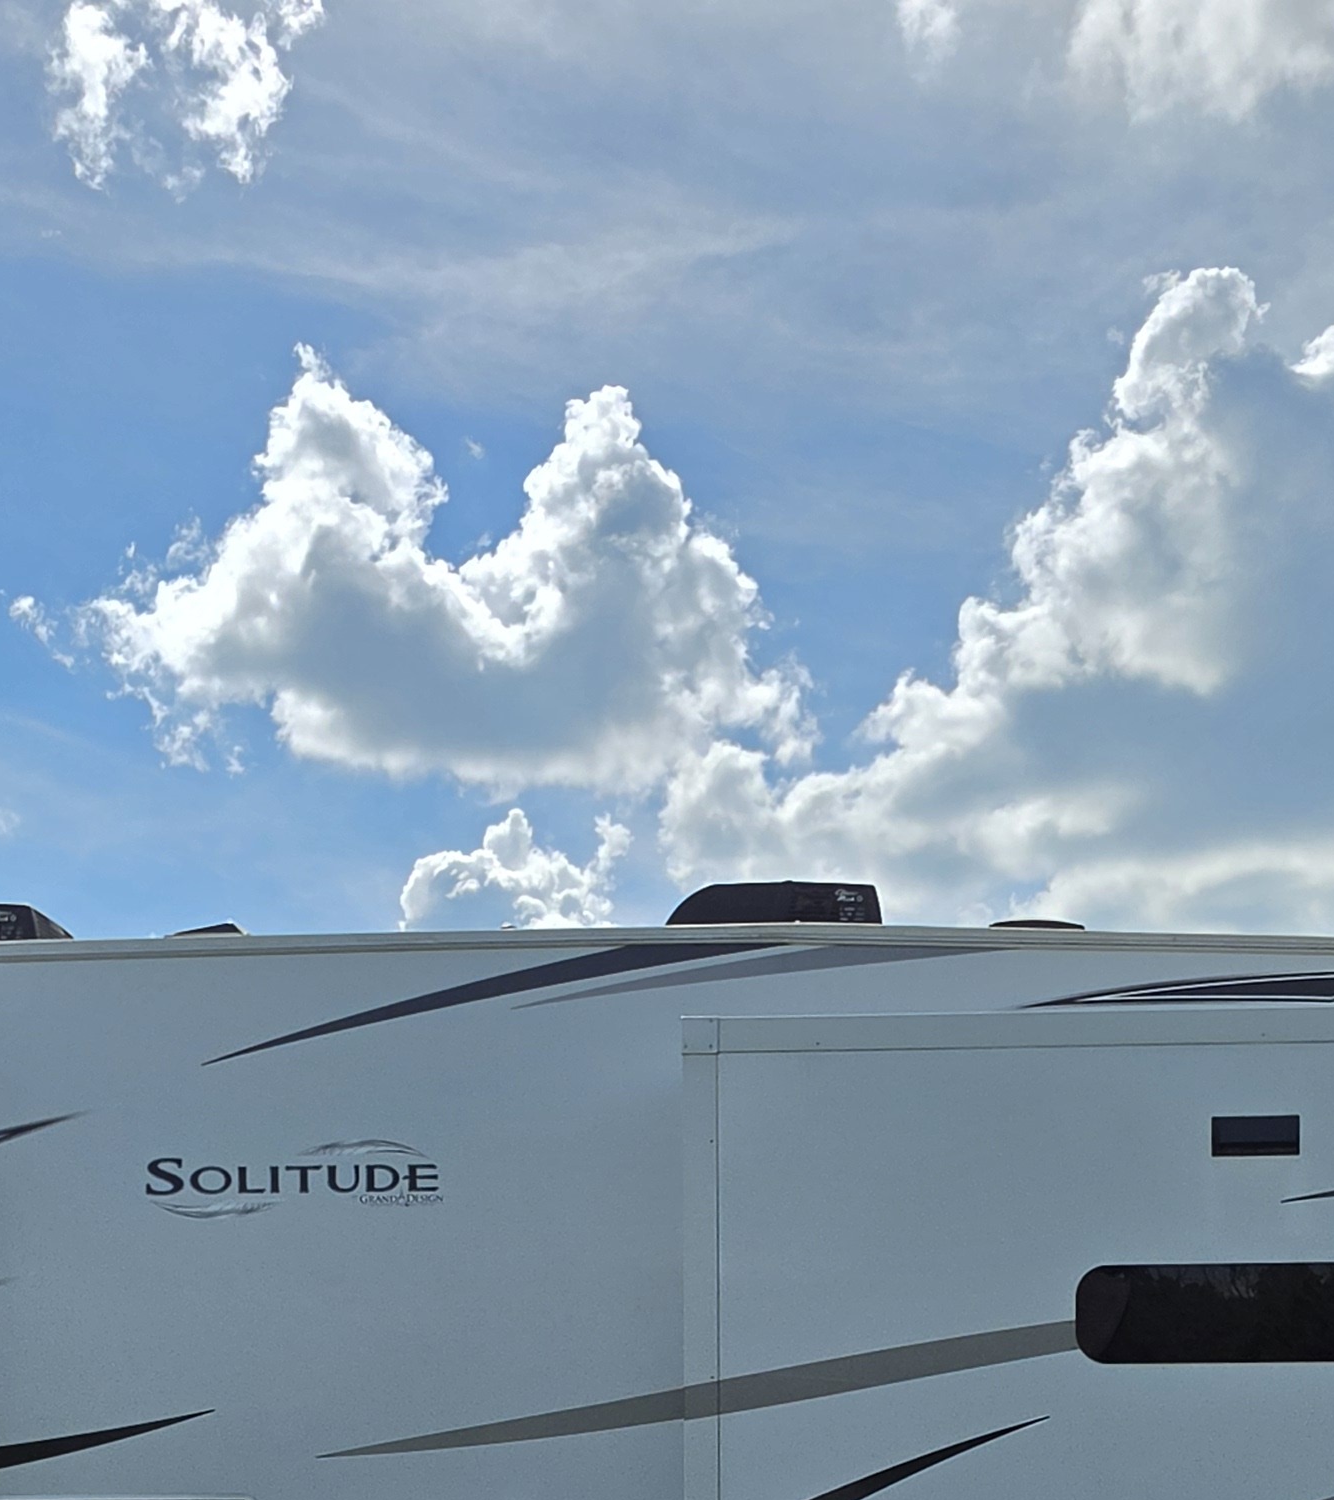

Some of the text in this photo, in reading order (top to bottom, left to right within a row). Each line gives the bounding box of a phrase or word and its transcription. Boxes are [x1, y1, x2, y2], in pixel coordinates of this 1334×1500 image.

[145, 1157, 440, 1196] SOLITUDE
[359, 1193, 444, 1206] GRAND DESIGN
